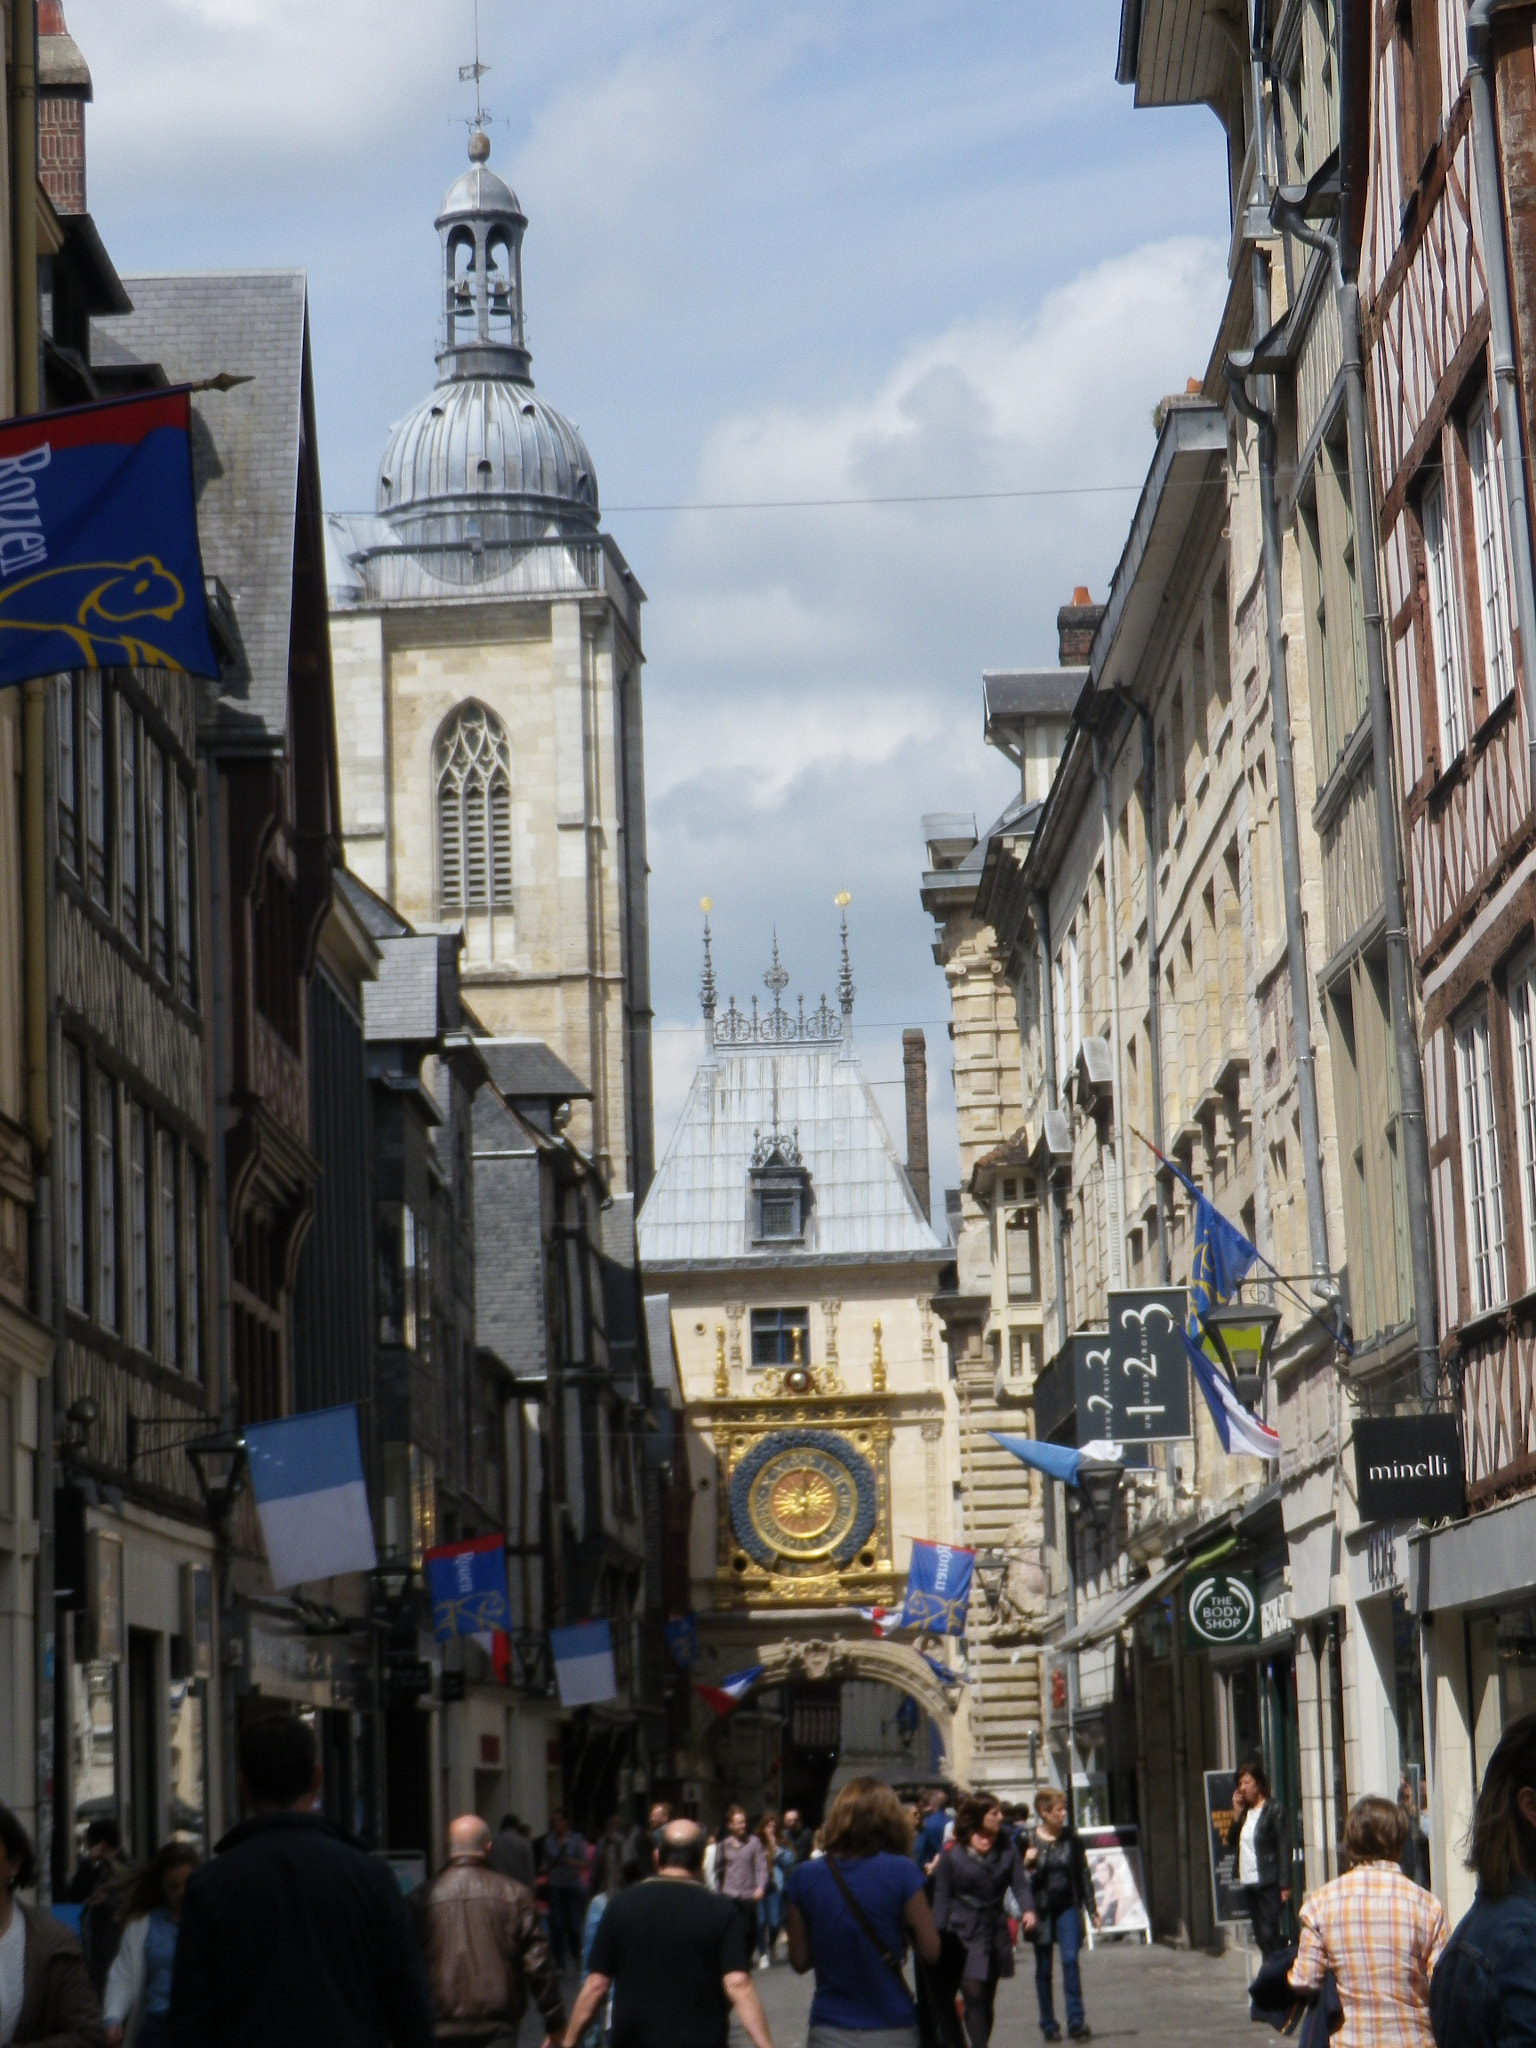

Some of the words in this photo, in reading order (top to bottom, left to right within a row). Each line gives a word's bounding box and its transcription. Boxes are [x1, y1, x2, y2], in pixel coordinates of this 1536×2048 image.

[0, 441, 51, 577] Rouen
[1121, 1303, 1174, 1333] 3
[1140, 1326, 1148, 1361] TROIS
[1123, 1353, 1157, 1377] 2
[1142, 1373, 1151, 1405] DEUX
[1369, 1455, 1448, 1480] minelli
[1202, 1606, 1242, 1618] BODY
[1210, 1596, 1233, 1606] THE
[1205, 1618, 1240, 1630] SHOP
